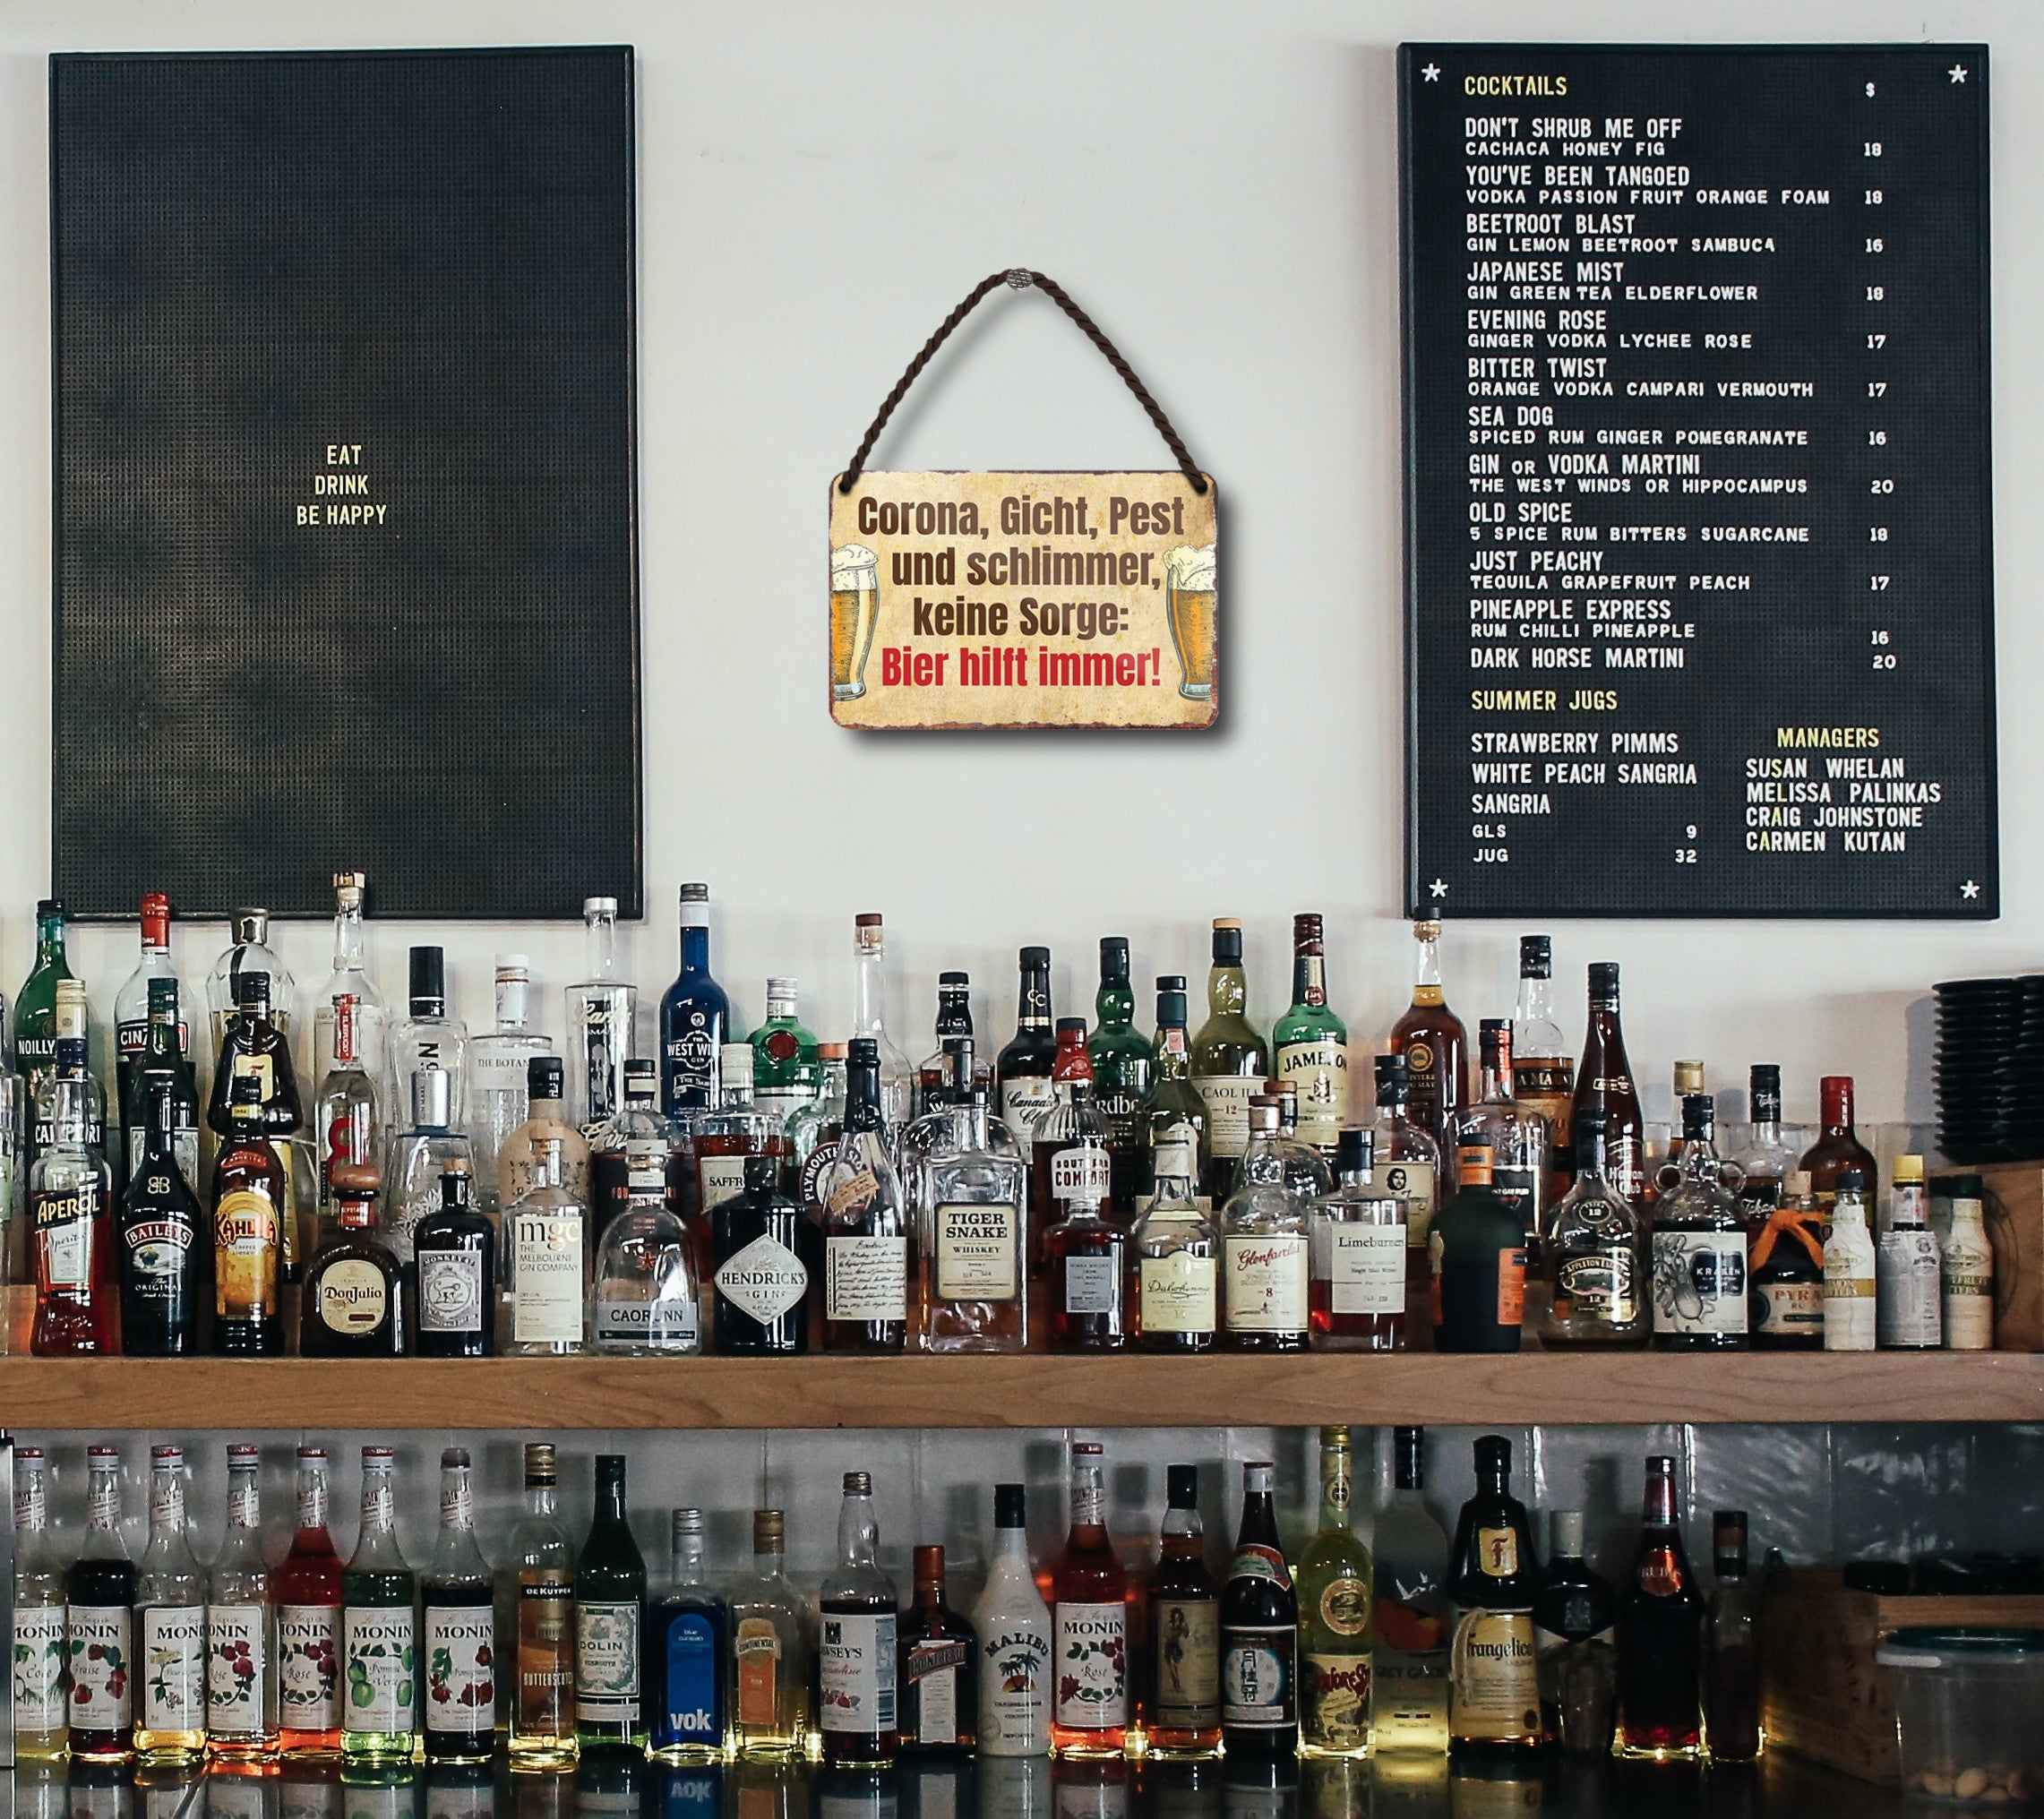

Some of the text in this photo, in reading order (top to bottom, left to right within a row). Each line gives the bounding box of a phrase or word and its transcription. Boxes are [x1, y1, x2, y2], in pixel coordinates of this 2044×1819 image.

[1464, 75, 1567, 96] COCKTAILS
[1464, 116, 1682, 139] DON'T SHRUB ME OFF
[1465, 141, 1882, 158] CACHACA HONEY FIG 18
[1465, 164, 1690, 187] YOU'VE BEEN TANGOED
[1465, 189, 1883, 205] VODKA PASSION FRUIT ORANGE FOAM 18
[1466, 213, 1636, 235] BEETROOT BLAST
[1466, 237, 1884, 253] GIN LEMON BEETROOT SAMBUCA 16
[1466, 261, 1624, 283] JAPANESE MIST
[1467, 285, 1884, 301] GIN GREEN TEA ELDERFLOWER 18
[1467, 309, 1607, 331] EVENING ROSE
[1467, 333, 1886, 349] GINGER VODKA LYCHEE ROSE 17
[1468, 357, 1607, 379] BITTER TWIST
[1467, 381, 1887, 398] ORANGE VODKA CAMPARI VERMOUTH 17
[1468, 406, 1554, 426] SEA DOG
[1469, 429, 1886, 446] SPICED RUM GINGER POMEGRANATE 16
[327, 444, 362, 466] EAT
[1469, 453, 1700, 476] GIN OR VODKA MARTINI
[314, 474, 369, 495] DRINK
[1469, 477, 1894, 494] THE WEST WINDS OR HIPPOCAMPUS 20
[296, 504, 387, 526] BE HAPPY
[858, 496, 1184, 539] Corona, Gicht, Pest
[1469, 502, 1573, 523] OLD SPICE
[1469, 526, 1888, 543] 5 SPICE RUM BITTERS SUGARCANE 18
[892, 546, 1160, 589] und schlimmer,
[1469, 550, 1603, 572] JUST PEACHY
[1470, 574, 1890, 591] TEQUILA GRAPEFRUIT PEACH 17
[914, 596, 1129, 640] keine Sorge:
[1470, 598, 1671, 621] PINEAPPLE EXPRESS
[1471, 622, 1889, 646] RUM CHILLI PINEAPPLE 16
[882, 647, 1161, 686] Bier hilft immer!
[1471, 647, 1897, 670] DARK HORSE MARTINI 20
[1471, 690, 1618, 711] SUMMER JUGS
[1471, 732, 1679, 754] STRAWBERRY PIMMS
[1777, 727, 1880, 749] MANAGERS
[1472, 762, 1697, 785] WHITE PEACH SANGRIA
[1746, 757, 1904, 779] SUSAN WHELAN
[1747, 782, 1942, 804] MELISSA PALINKAS
[1472, 793, 1551, 815] SANGRIA
[1746, 806, 1923, 828] CRAIG JOHNSTONE
[1472, 824, 1697, 839] GLS 9
[1746, 830, 1906, 853] CARMEN KUTAN
[1473, 847, 1697, 863] JUG 32
[18, 1039, 56, 1055] NOILLY
[667, 1043, 694, 1057] WEST
[478, 1060, 493, 1068] THE
[1203, 1086, 1237, 1099] CAOL
[1224, 1104, 1237, 1115] 12
[38, 1194, 100, 1224] APEROL
[948, 1213, 1005, 1225] TIGER
[129, 1223, 189, 1244] BAILEYS
[519, 1221, 580, 1252] mgc
[946, 1226, 1009, 1239] SNAKE
[519, 1244, 536, 1253] THE
[519, 1254, 572, 1263] MELBOURNE
[952, 1246, 1001, 1254] WHISKEY
[519, 1264, 580, 1272] GIN COMPANY
[721, 1272, 805, 1285] HENDRICK'S
[751, 1290, 780, 1299] GIN
[1265, 1286, 1274, 1298] 8
[610, 1309, 683, 1323] CAORNN
[353, 1626, 412, 1639] MONIN
[434, 1626, 494, 1639] MONIN
[1063, 1621, 1124, 1635] MONIN
[580, 1641, 623, 1651] DOLIN
[983, 1632, 1050, 1658] MALIBU
[670, 1709, 713, 1731] vok
